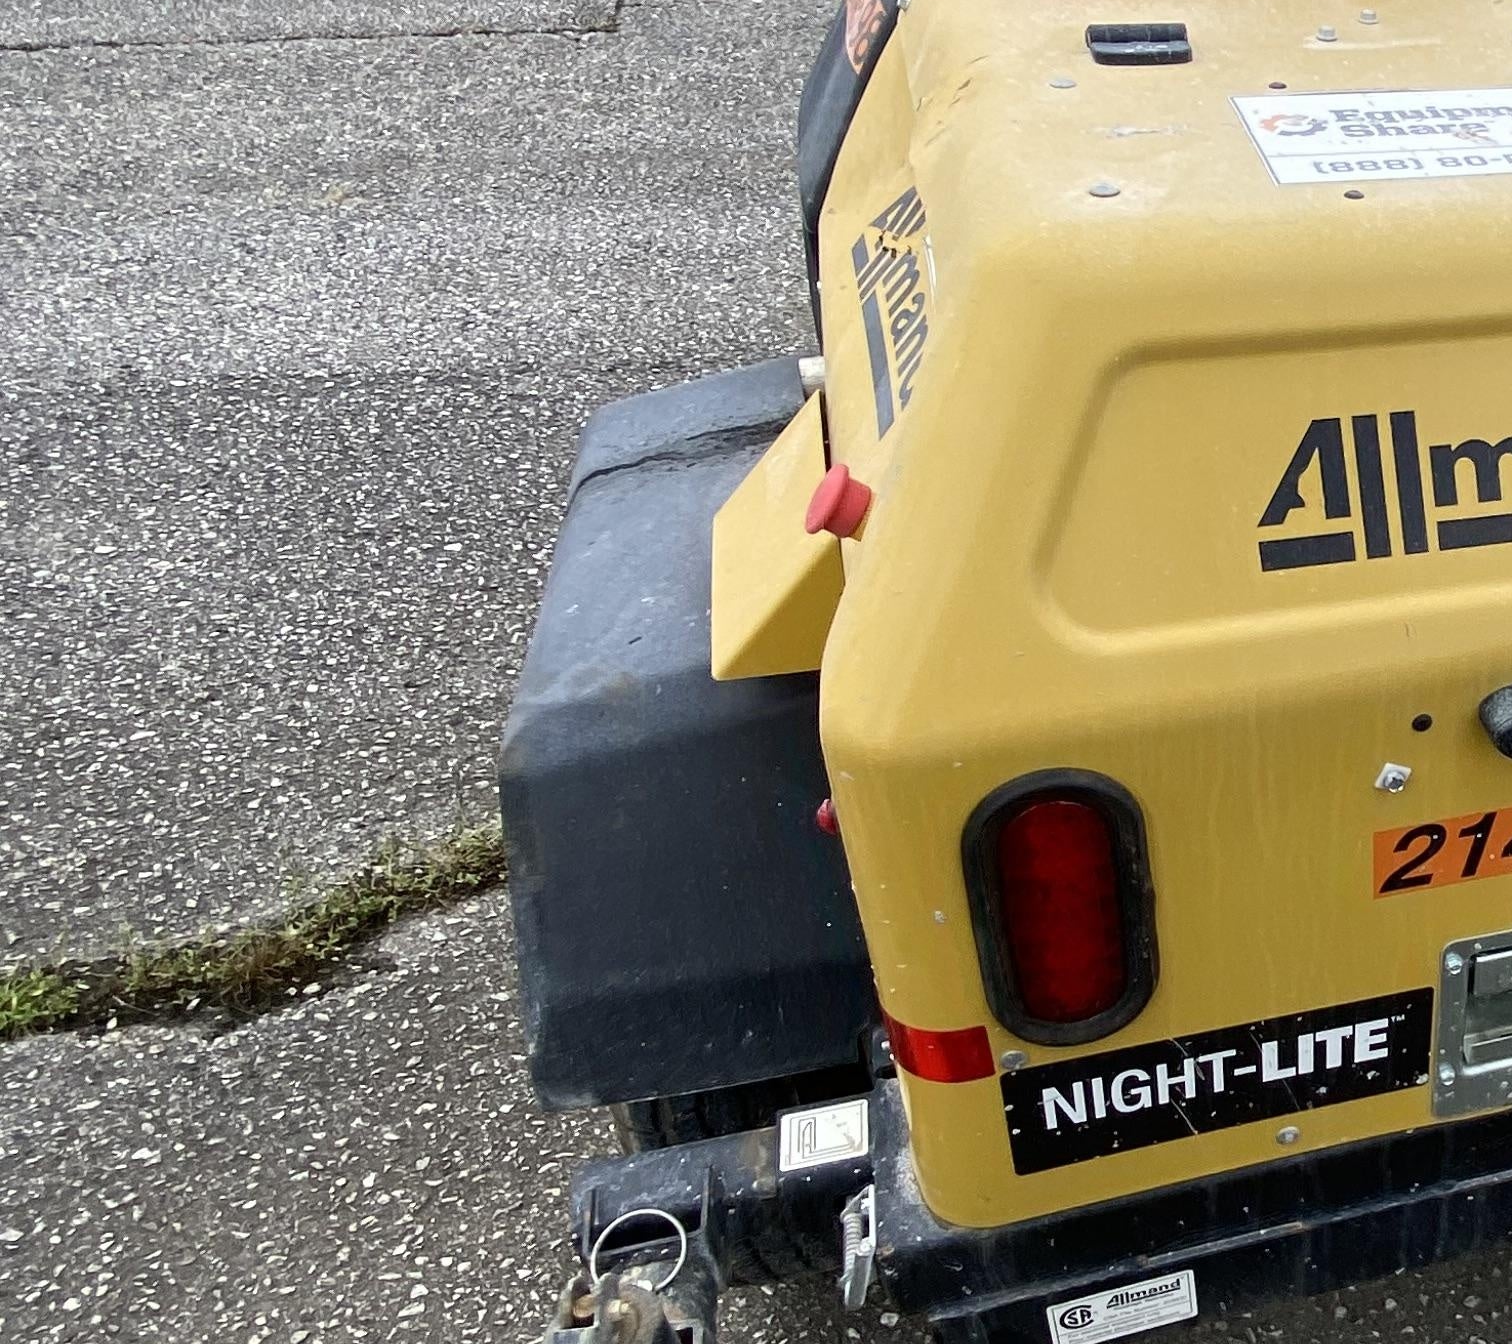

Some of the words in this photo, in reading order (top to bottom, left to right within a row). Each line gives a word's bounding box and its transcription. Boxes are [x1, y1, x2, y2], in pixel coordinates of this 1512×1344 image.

[1342, 122, 1489, 137] Share
[1313, 158, 1424, 174] (888)
[1041, 1018, 1390, 1130] NIGHT-LITE
[1106, 1278, 1181, 1309] Allmand
